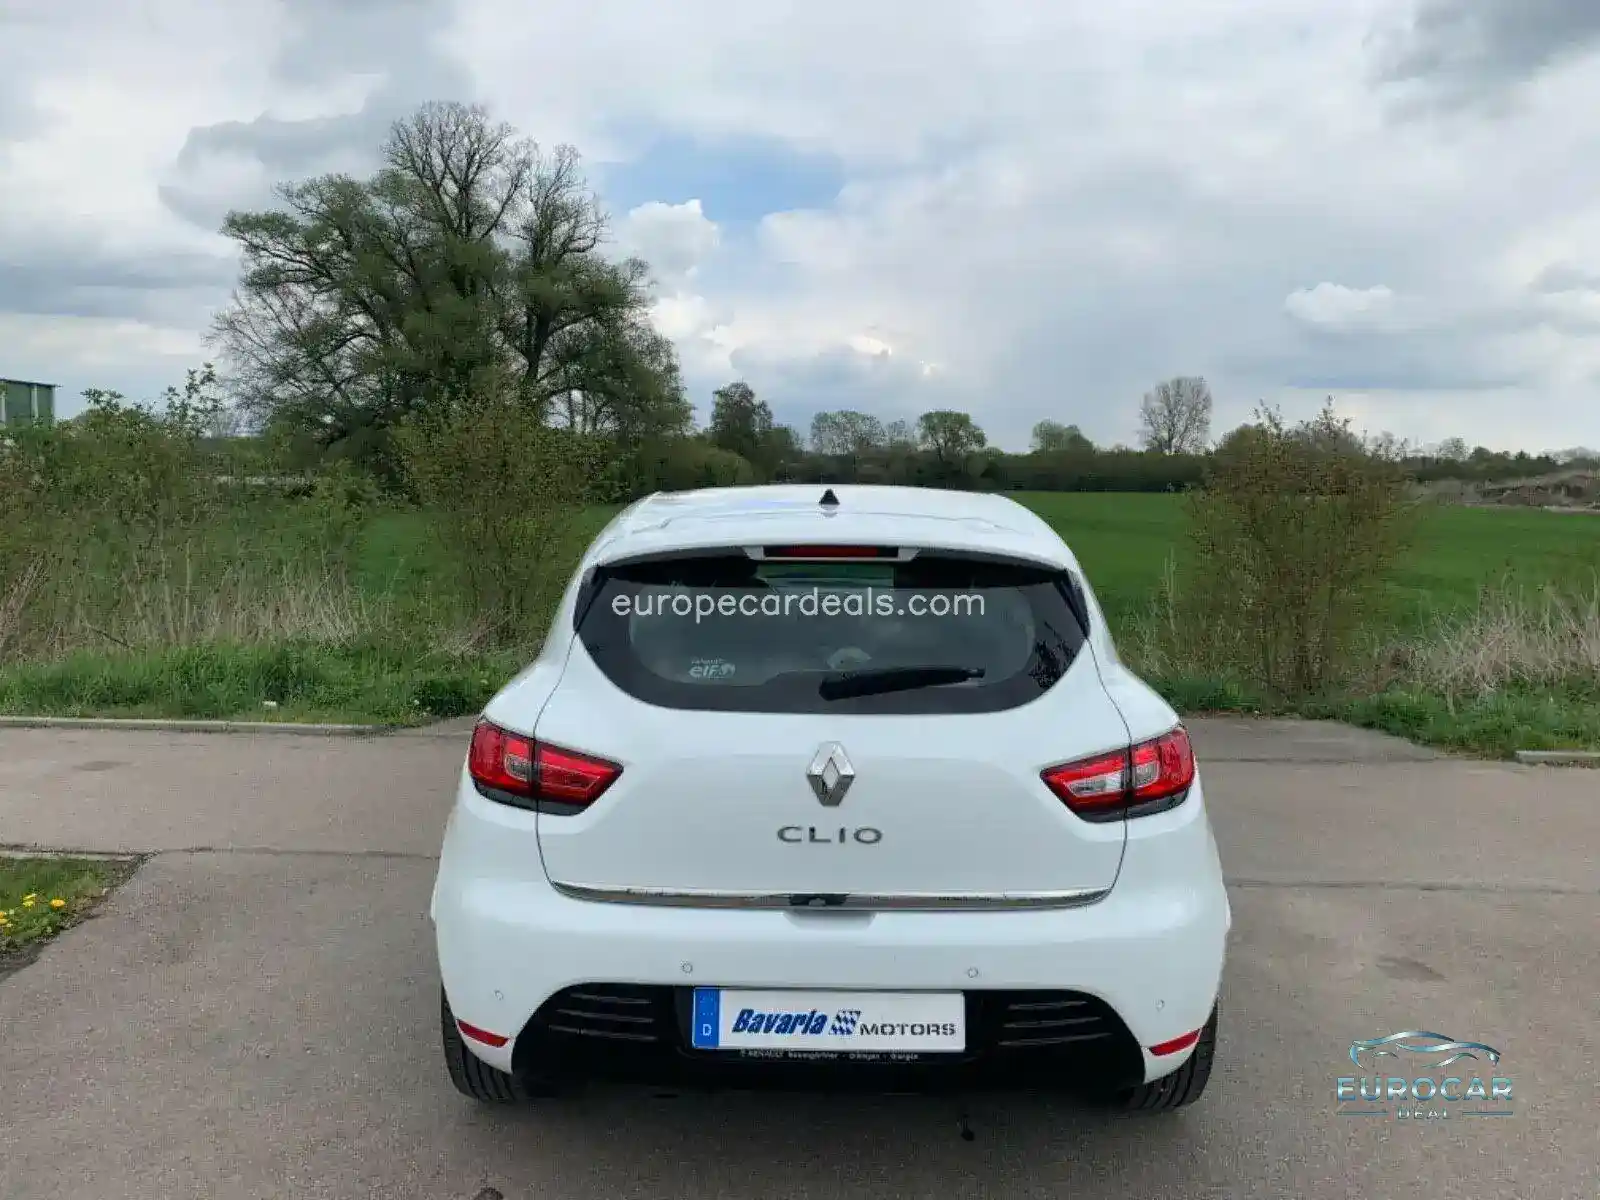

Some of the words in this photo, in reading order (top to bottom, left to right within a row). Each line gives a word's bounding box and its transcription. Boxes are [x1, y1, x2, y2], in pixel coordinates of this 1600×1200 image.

[777, 826, 882, 844] CLIO
[702, 1024, 712, 1036] D
[732, 1008, 828, 1035] Bavaria
[859, 1023, 956, 1036] MOTORS
